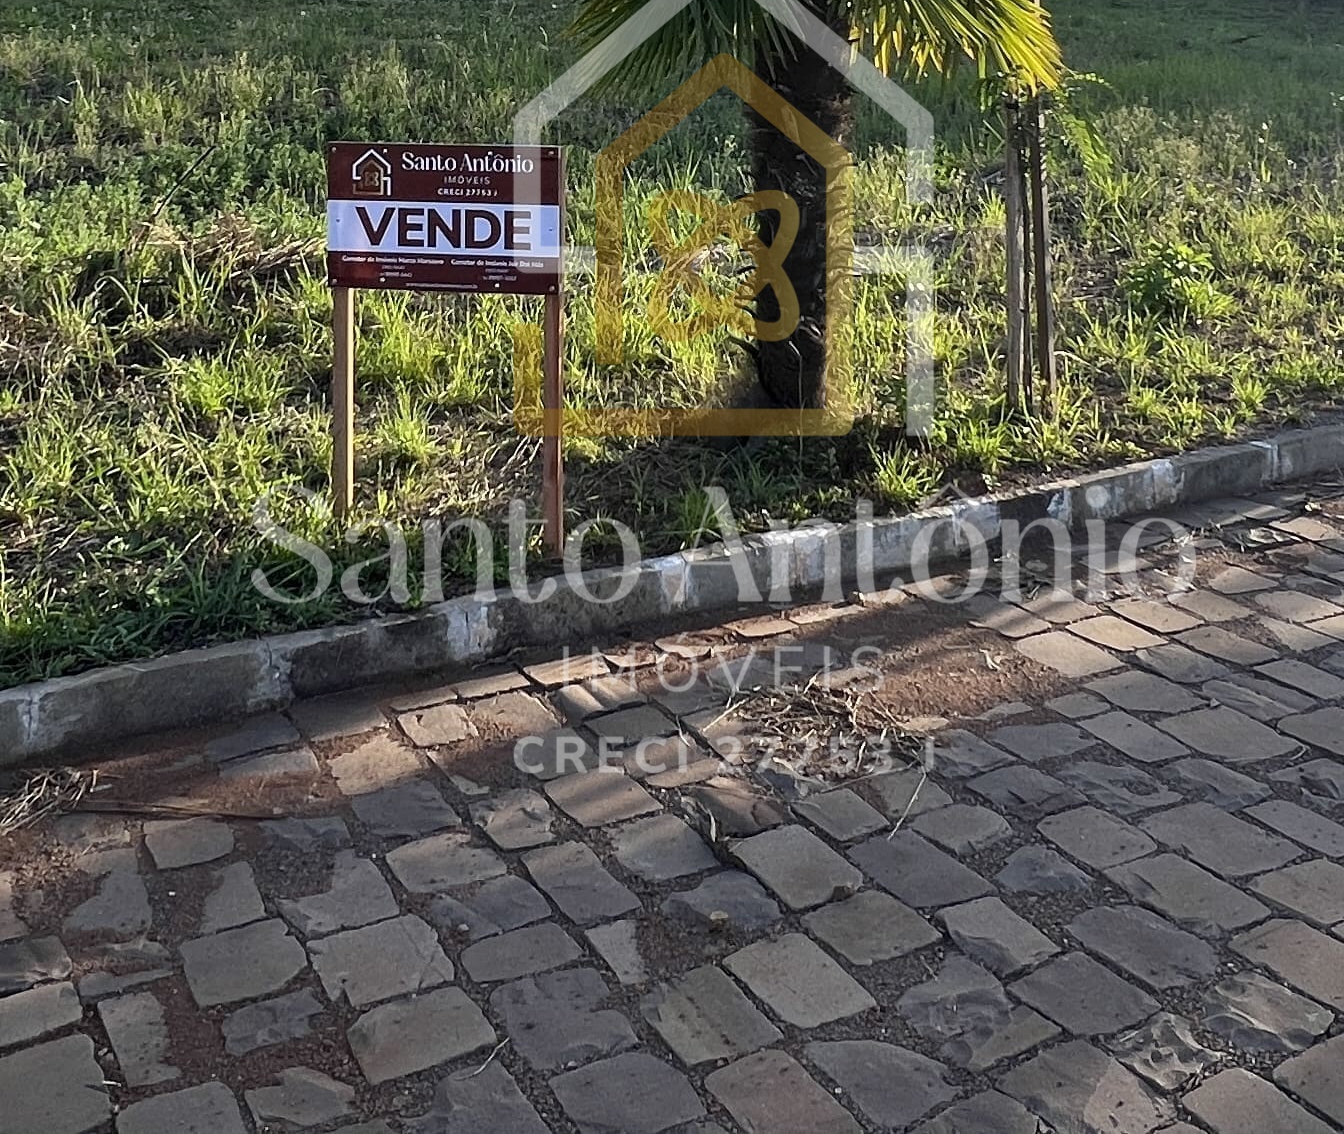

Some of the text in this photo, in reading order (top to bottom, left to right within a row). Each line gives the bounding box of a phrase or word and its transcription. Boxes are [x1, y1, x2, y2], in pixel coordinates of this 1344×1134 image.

[401, 151, 534, 174] Santo Antônio
[355, 206, 532, 251] VENDE
